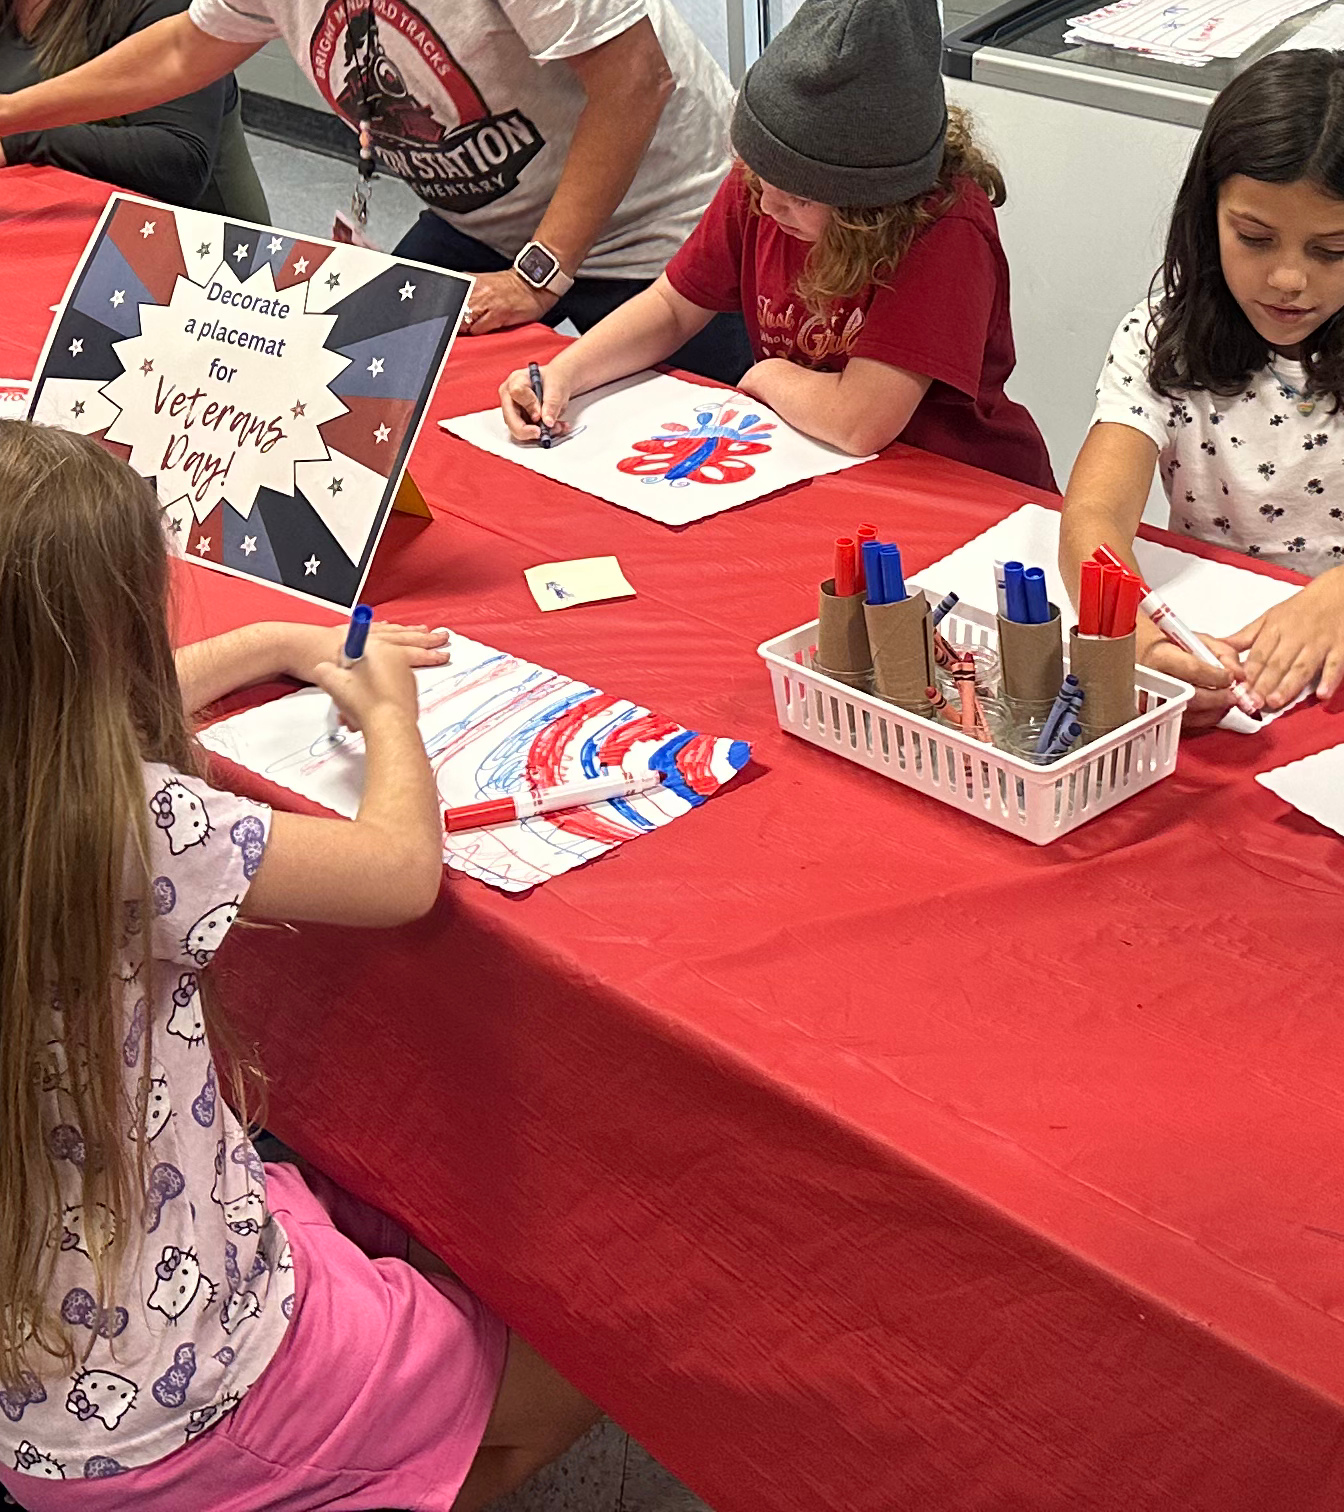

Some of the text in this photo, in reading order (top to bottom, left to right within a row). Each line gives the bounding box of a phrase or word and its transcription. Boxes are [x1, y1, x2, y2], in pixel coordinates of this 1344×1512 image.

[315, 17, 336, 80] BRIGHT
[399, 12, 451, 77] TRACKS
[409, 116, 535, 180] STATION
[411, 172, 505, 199] MENTARY
[207, 281, 291, 320] Decorate
[757, 295, 795, 329] Just
[184, 318, 286, 358] a placemat
[208, 357, 238, 384] for
[154, 375, 288, 453] Veterans
[160, 434, 234, 500] Day!
